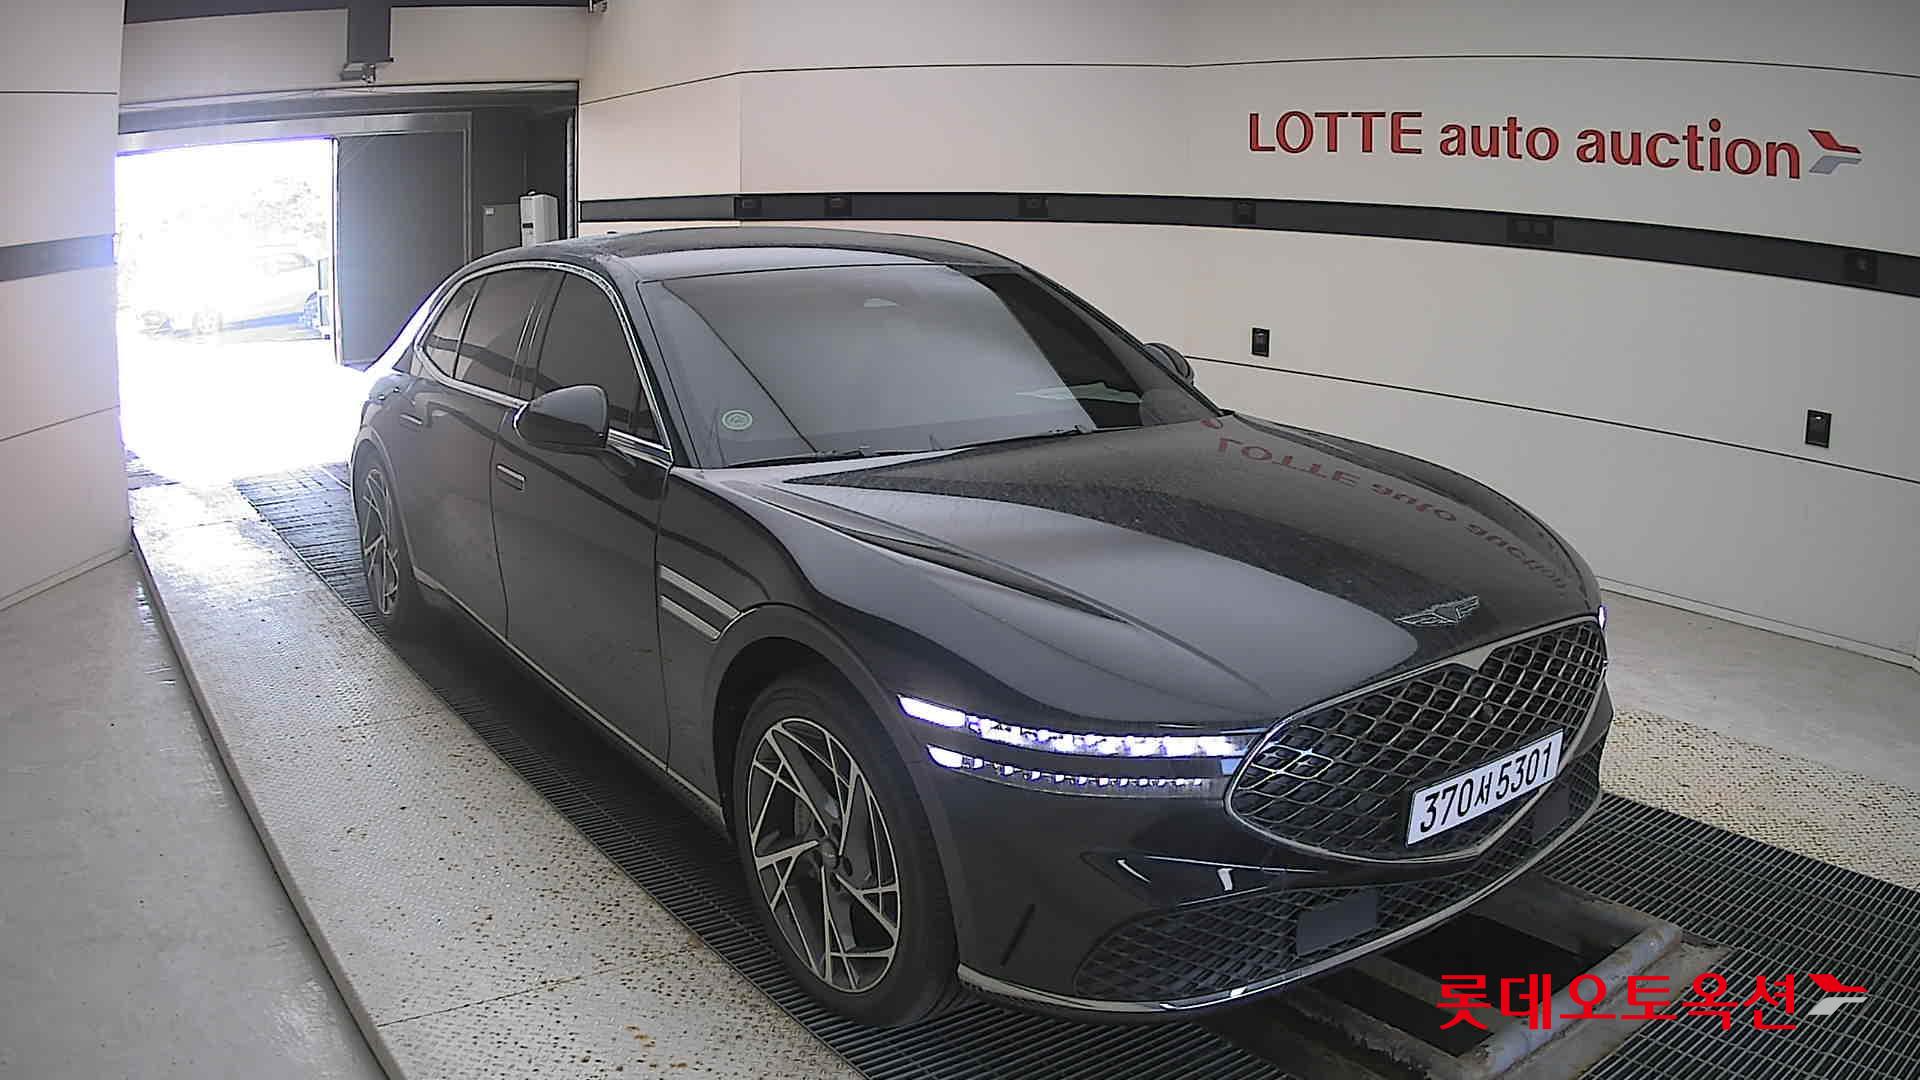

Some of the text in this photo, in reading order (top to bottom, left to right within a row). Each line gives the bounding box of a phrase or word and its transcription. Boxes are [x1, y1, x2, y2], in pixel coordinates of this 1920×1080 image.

[1249, 111, 1801, 179] LOTTE auto auction
